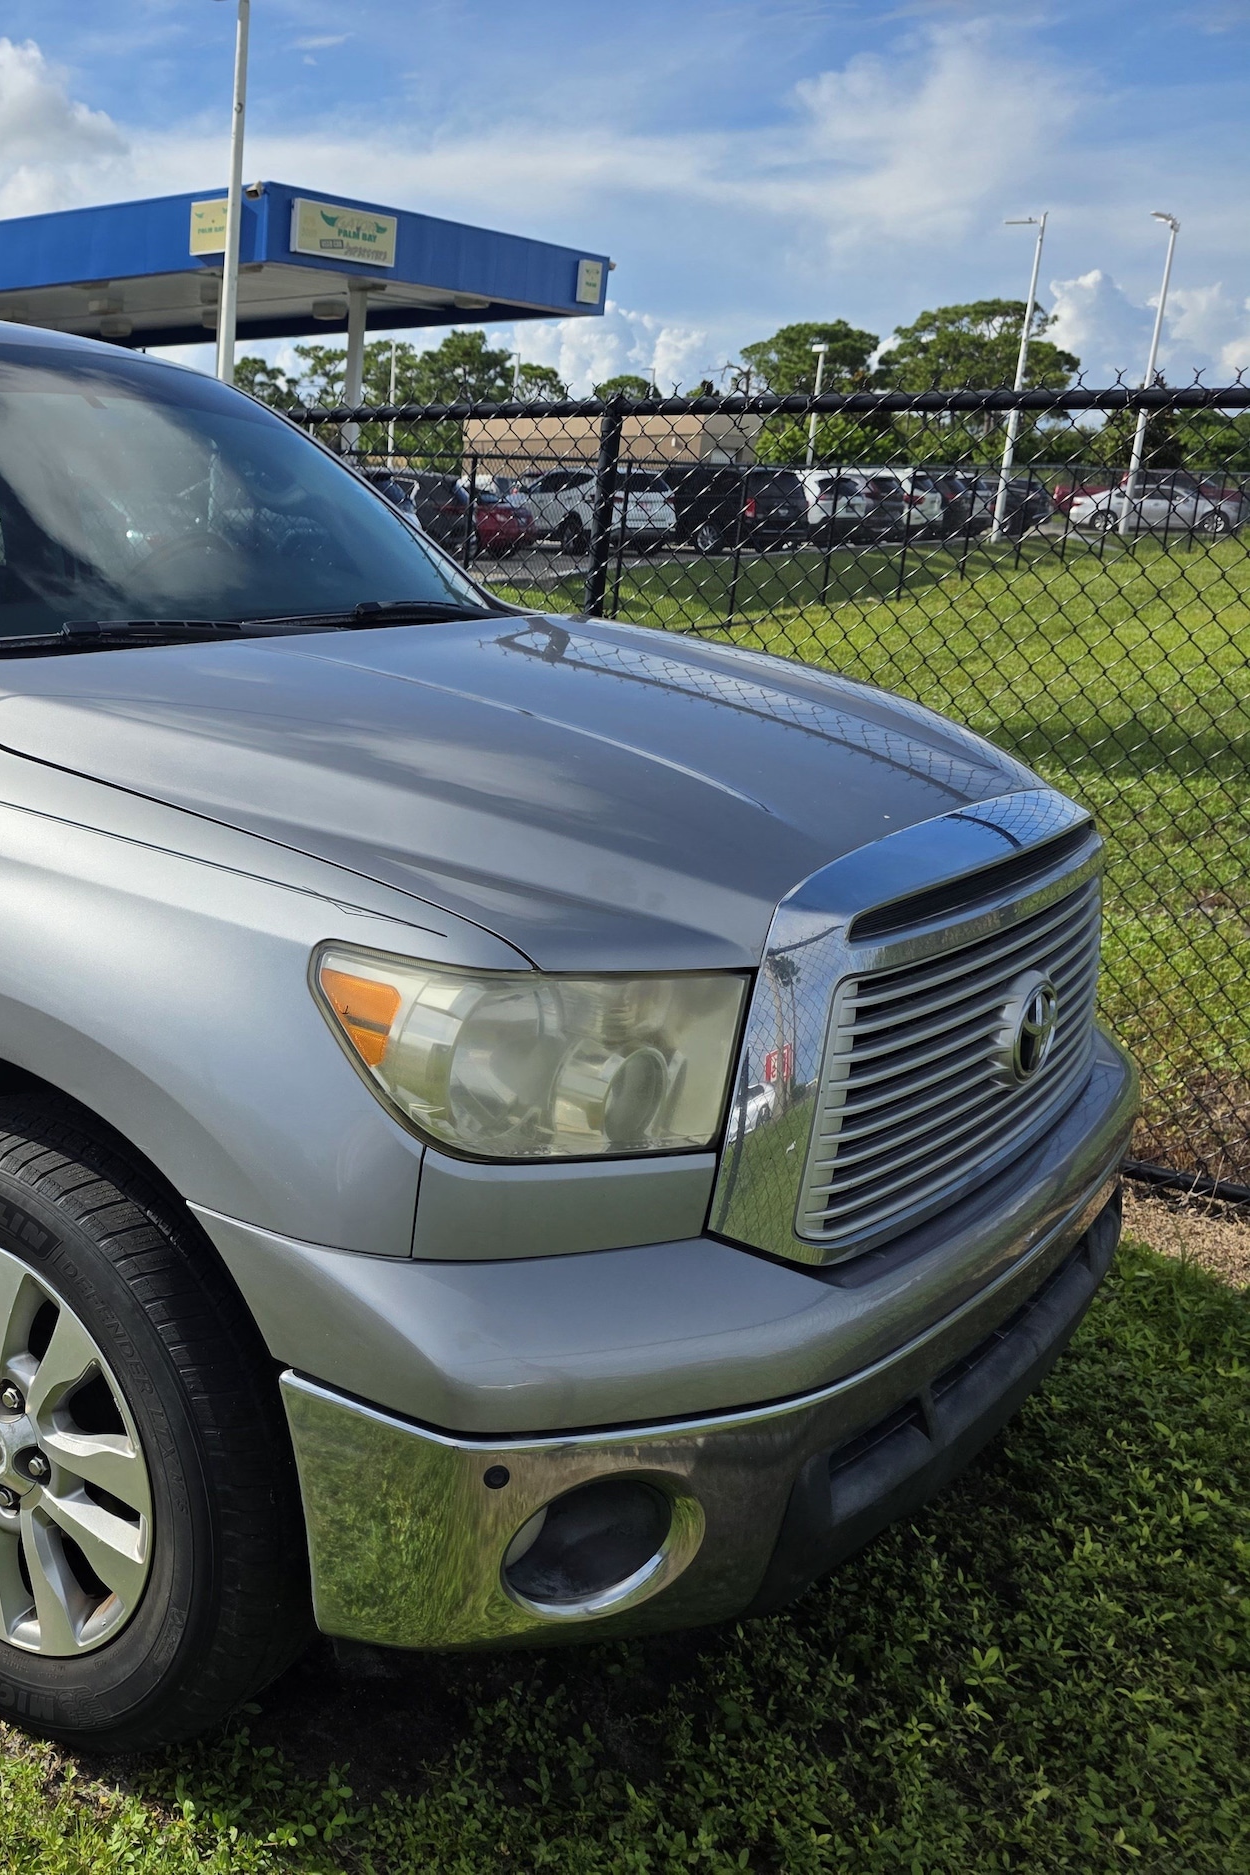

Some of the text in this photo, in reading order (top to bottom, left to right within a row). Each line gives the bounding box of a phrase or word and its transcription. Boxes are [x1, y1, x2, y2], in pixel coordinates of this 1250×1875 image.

[338, 228, 377, 243] PALM BAY
[61, 1259, 154, 1395] DEFENDER
